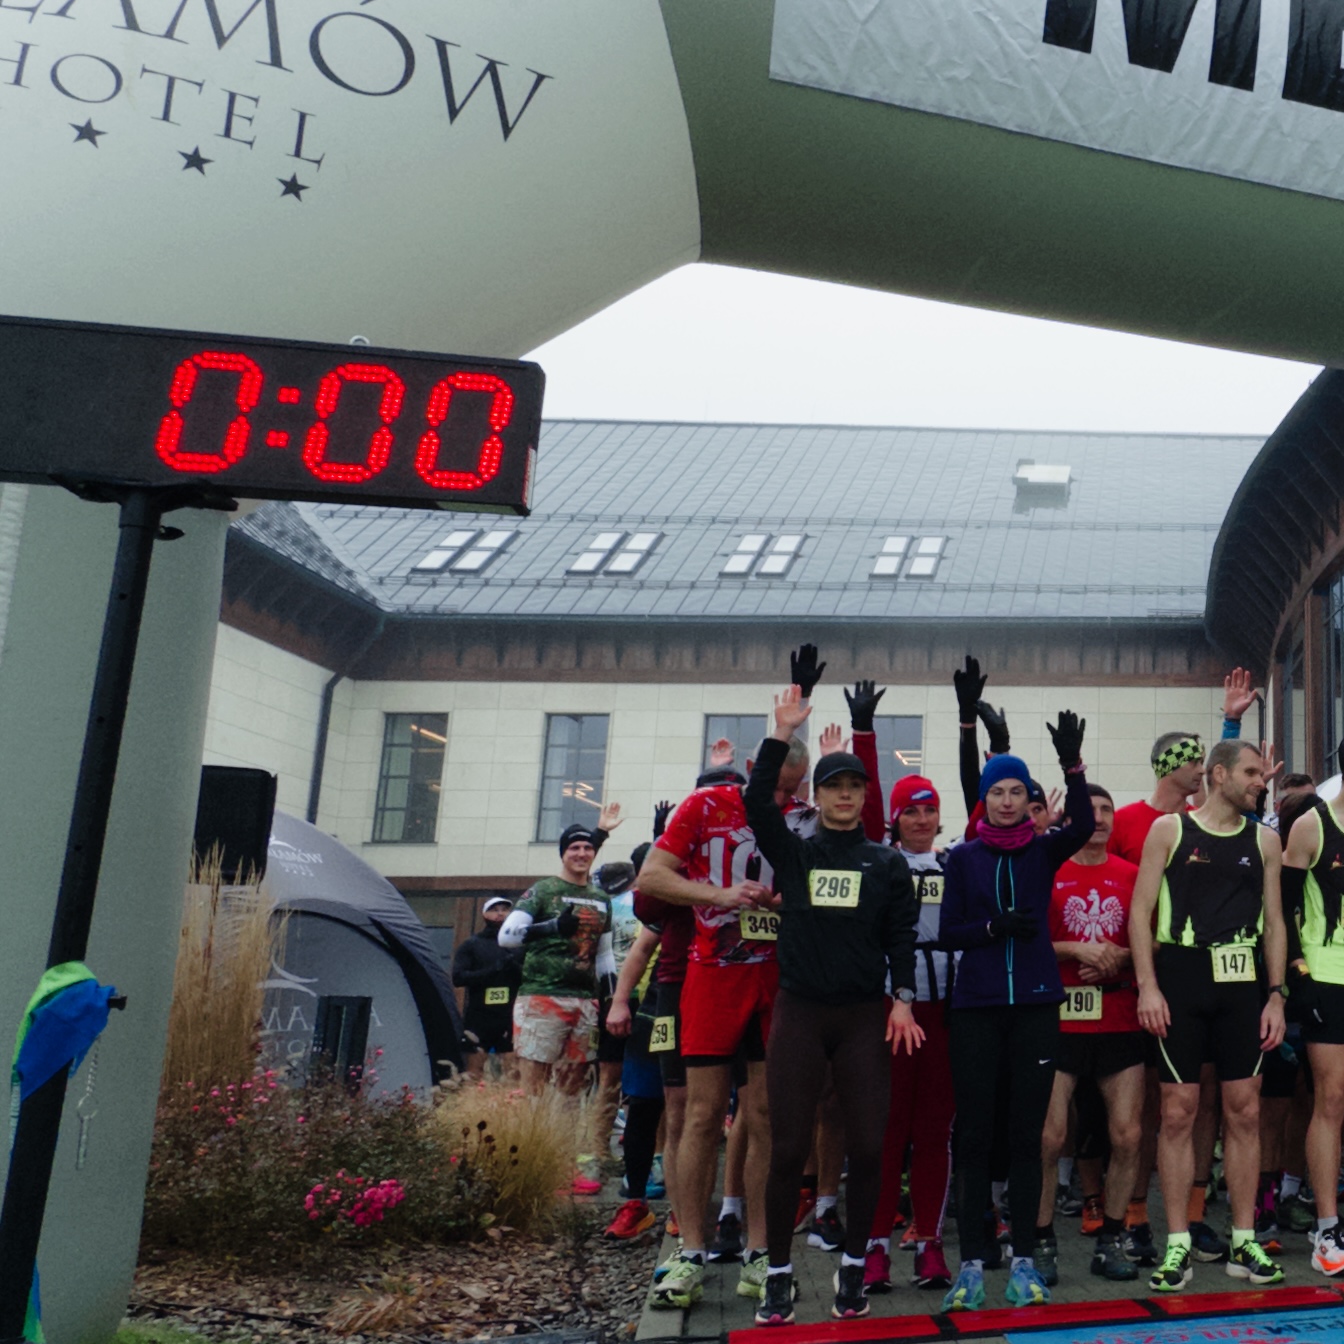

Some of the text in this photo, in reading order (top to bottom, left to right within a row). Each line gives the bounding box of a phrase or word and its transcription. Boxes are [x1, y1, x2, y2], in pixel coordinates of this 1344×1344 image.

[156, 352, 515, 491] 0:00
[815, 876, 852, 898] 296
[920, 882, 938, 897] 68
[747, 916, 779, 934] 349
[1220, 954, 1247, 974] 147
[1066, 992, 1094, 1012] 190
